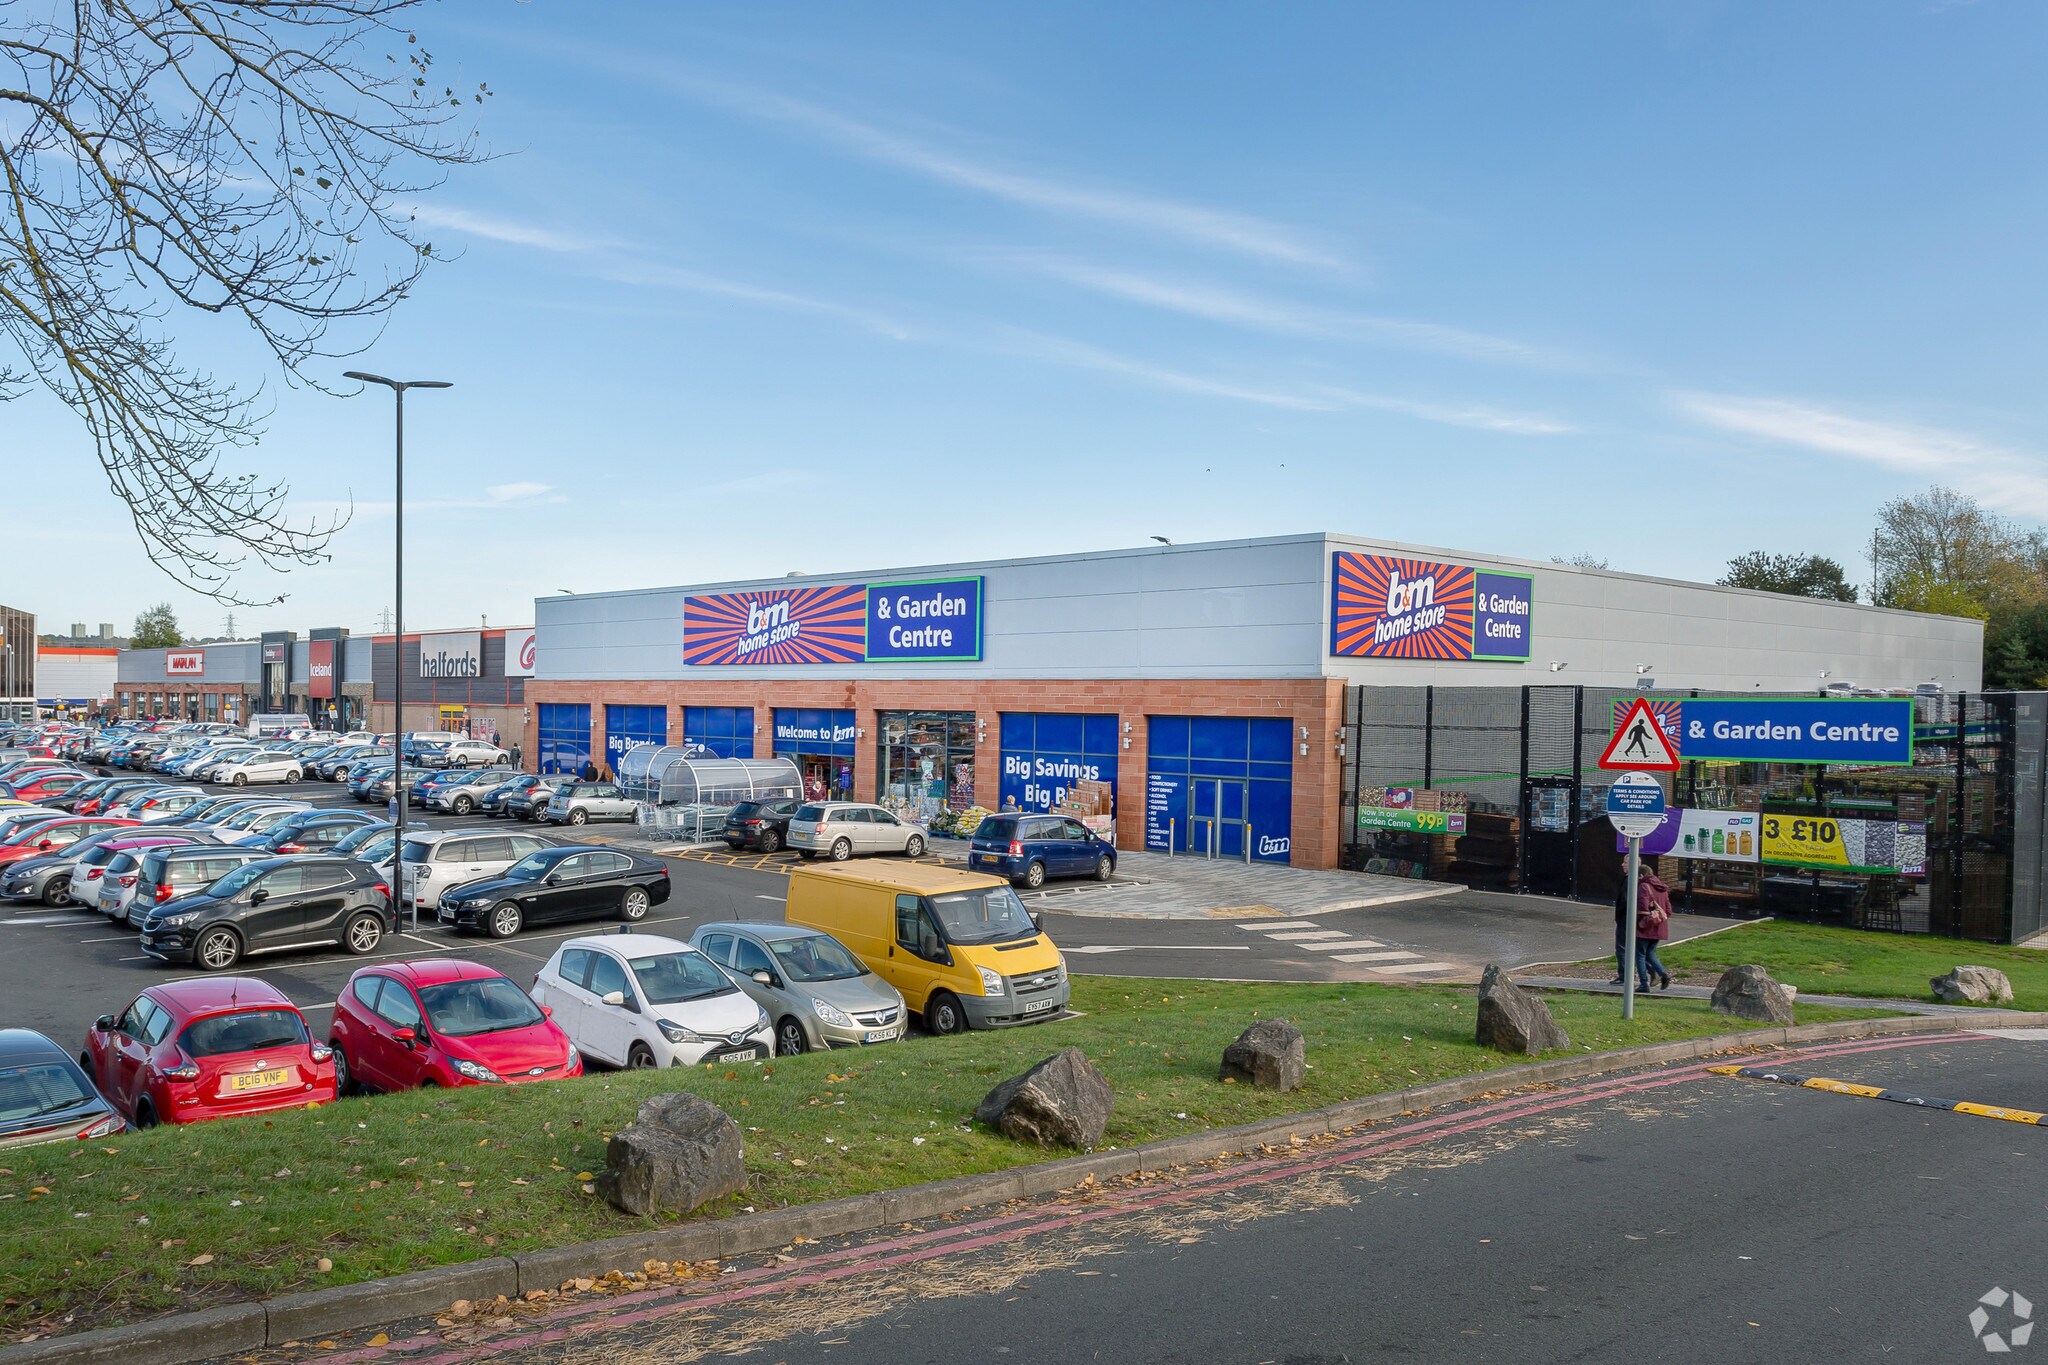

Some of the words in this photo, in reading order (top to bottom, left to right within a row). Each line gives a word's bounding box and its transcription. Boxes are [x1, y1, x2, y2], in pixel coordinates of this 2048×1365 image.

[878, 597, 891, 619] &
[896, 593, 966, 618] Garden
[1478, 593, 1487, 612] &
[1490, 593, 1528, 615] Garden
[1374, 618, 1411, 644] home
[1413, 604, 1445, 632] store
[1485, 618, 1521, 639] Centre
[738, 632, 768, 656] home
[770, 620, 800, 645] store
[889, 625, 952, 648] Centre
[172, 657, 197, 669] MATALAN
[310, 662, 332, 676] Iceland
[422, 651, 477, 677] halfords
[777, 725, 818, 739] Welcome
[820, 727, 831, 740] to
[1689, 720, 1706, 739] &
[1713, 720, 1801, 741] Garden
[1810, 721, 1900, 743] Centre
[609, 736, 623, 753] Big
[1005, 756, 1031, 780] Big
[1035, 757, 1099, 780] Savings
[1025, 784, 1051, 808] Big
[1361, 808, 1376, 816] Now
[1378, 809, 1384, 817] in
[1361, 816, 1386, 826] Garden
[1388, 818, 1411, 828] Centre
[1416, 812, 1443, 830] 99p
[1765, 819, 1780, 839] 3
[1791, 819, 1836, 843] £10
[739, 1051, 752, 1061] AVR
[239, 1075, 260, 1087] BC16
[263, 1071, 281, 1083] VNF
